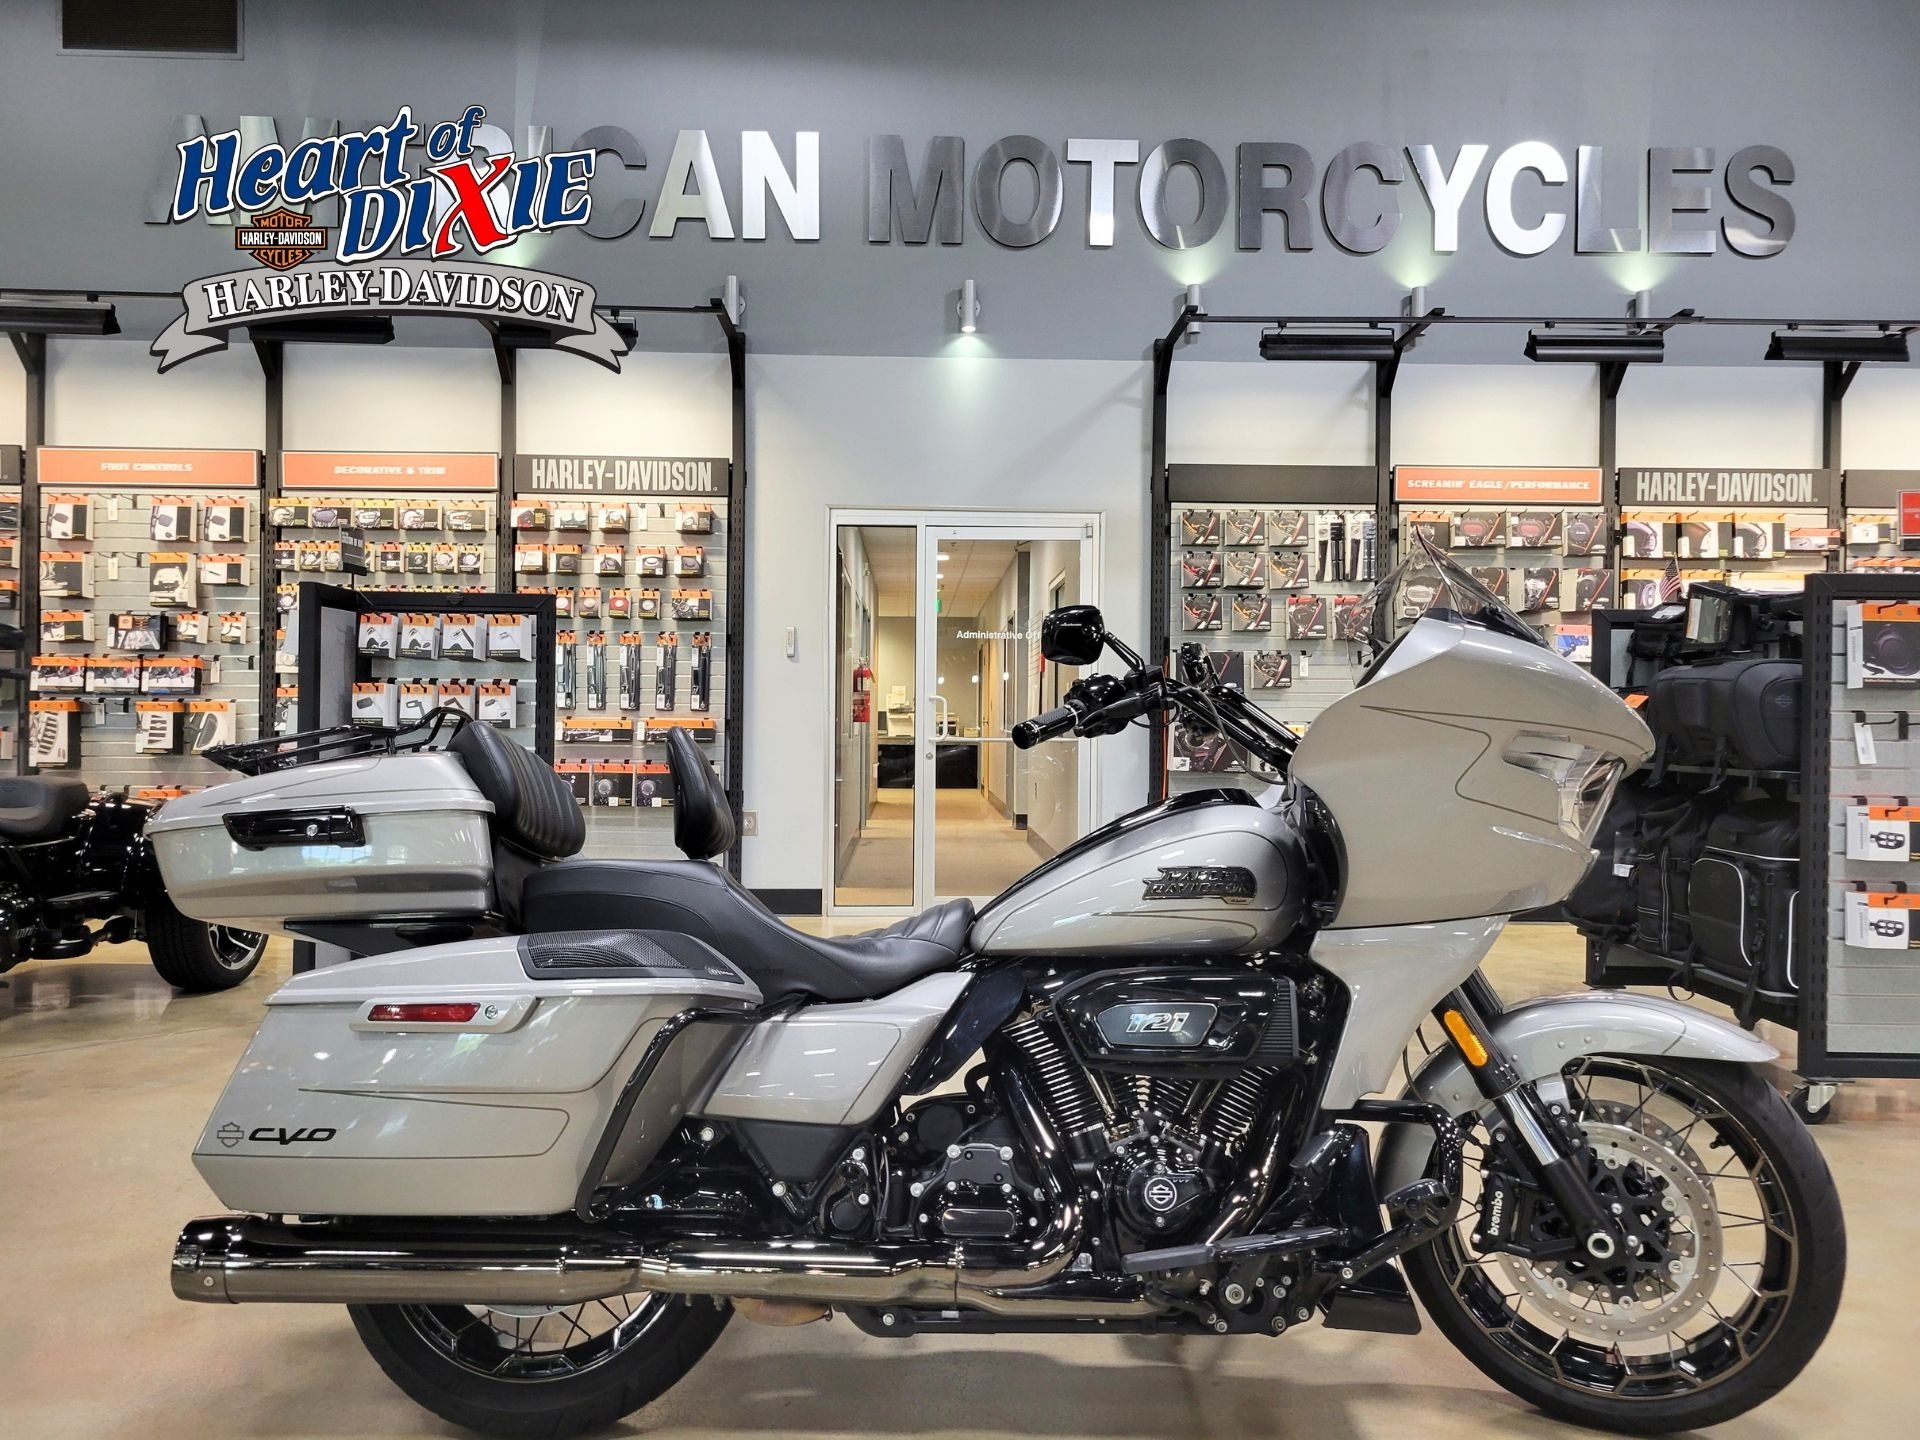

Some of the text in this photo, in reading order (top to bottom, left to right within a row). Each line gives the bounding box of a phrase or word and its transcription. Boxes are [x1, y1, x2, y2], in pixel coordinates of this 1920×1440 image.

[144, 114, 1796, 257] AMRCAN MOTORCYCLES
[101, 462, 193, 472] FOOT CONTROLS
[334, 466, 446, 475] DECORATIVE & TRIM
[531, 458, 713, 492] HARLEY-DAVIDSON
[1636, 471, 1813, 503] HARLEY-DAVIDSON
[956, 630, 1023, 640] Administrative
[1126, 1012, 1190, 1033] 121
[248, 1127, 337, 1145] CVO
[1487, 1190, 1504, 1236] brembo
